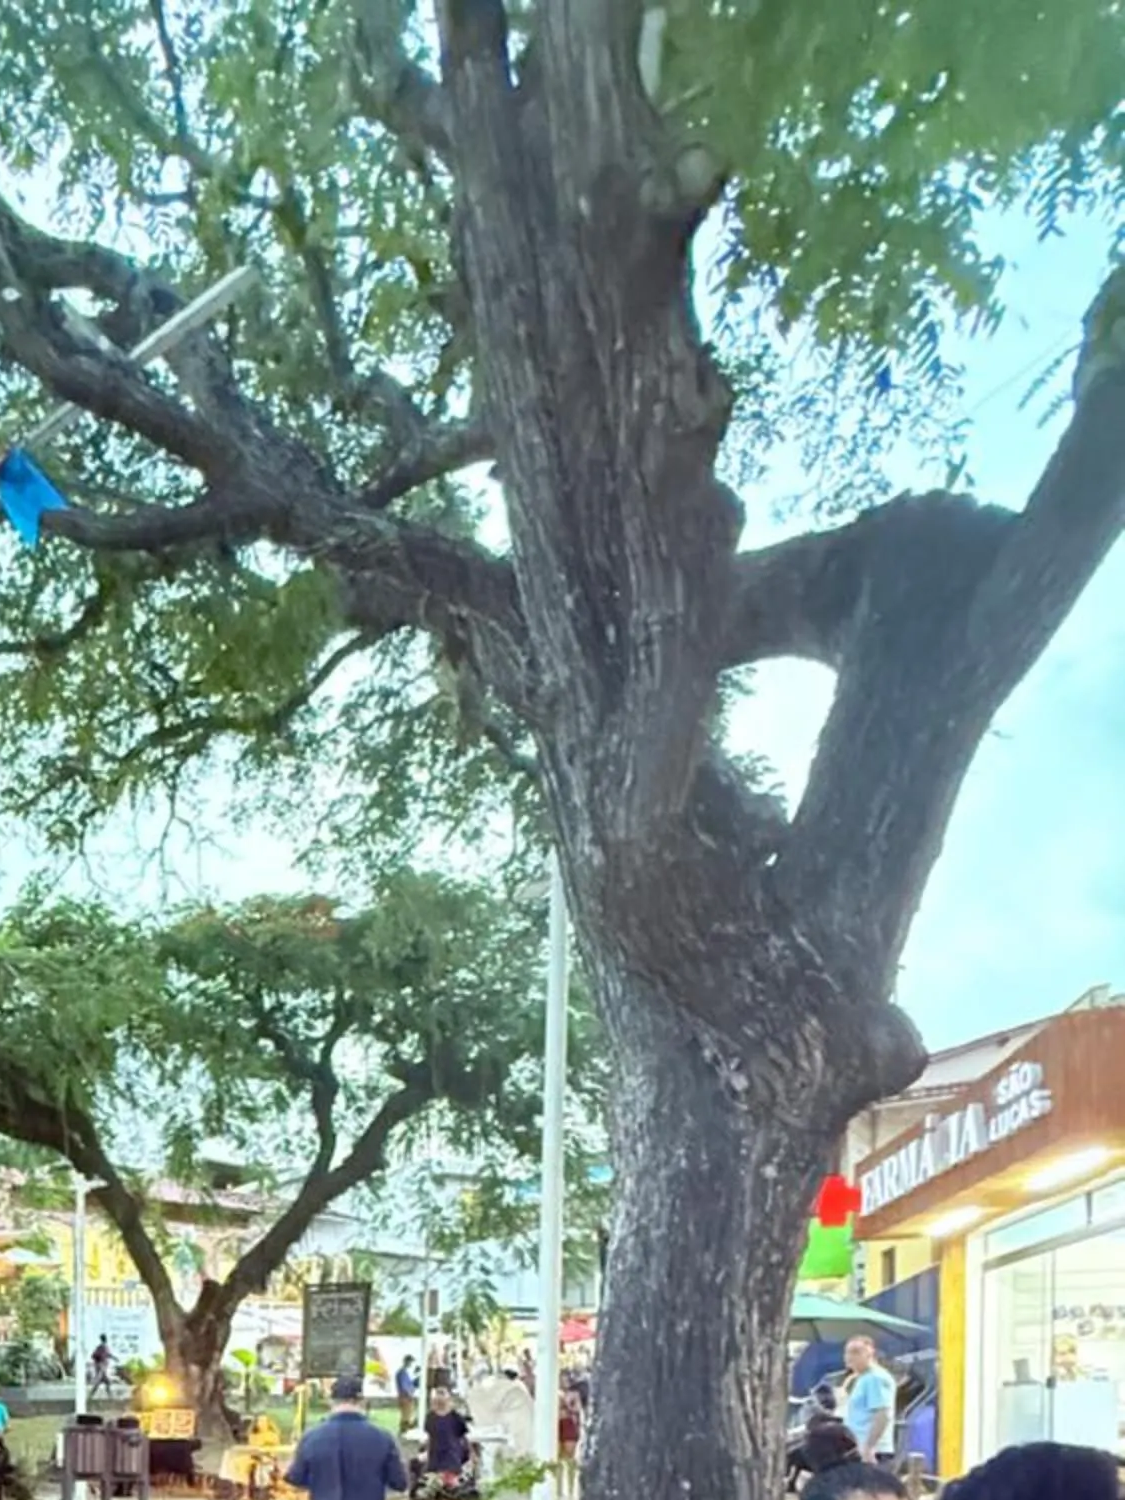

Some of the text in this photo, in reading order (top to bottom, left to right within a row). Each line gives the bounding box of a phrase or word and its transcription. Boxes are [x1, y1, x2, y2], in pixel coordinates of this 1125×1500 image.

[995, 1061, 1043, 1103] SÃO
[989, 1089, 1052, 1141] LUCAS
[860, 1103, 986, 1217] FARMÁIA
